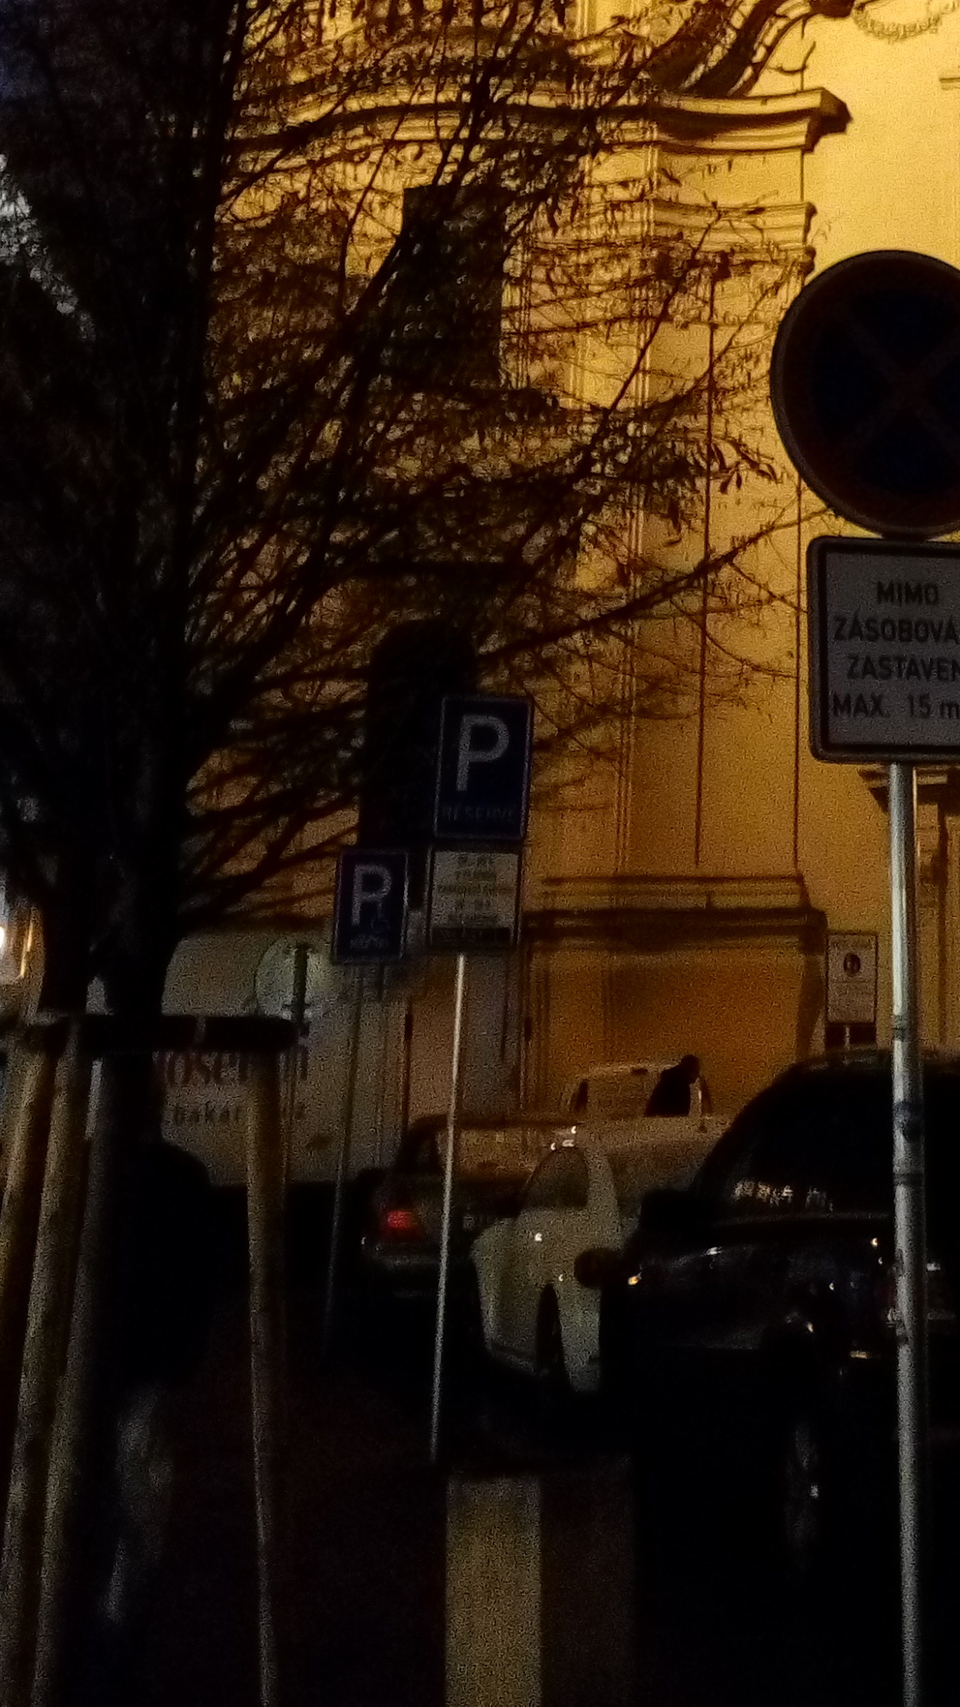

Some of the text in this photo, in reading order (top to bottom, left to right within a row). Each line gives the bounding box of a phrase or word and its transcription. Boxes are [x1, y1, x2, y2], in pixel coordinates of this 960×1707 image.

[876, 581, 938, 605] MIMO
[908, 693, 930, 719] 15
[456, 714, 509, 792] P
[351, 863, 392, 926] P
